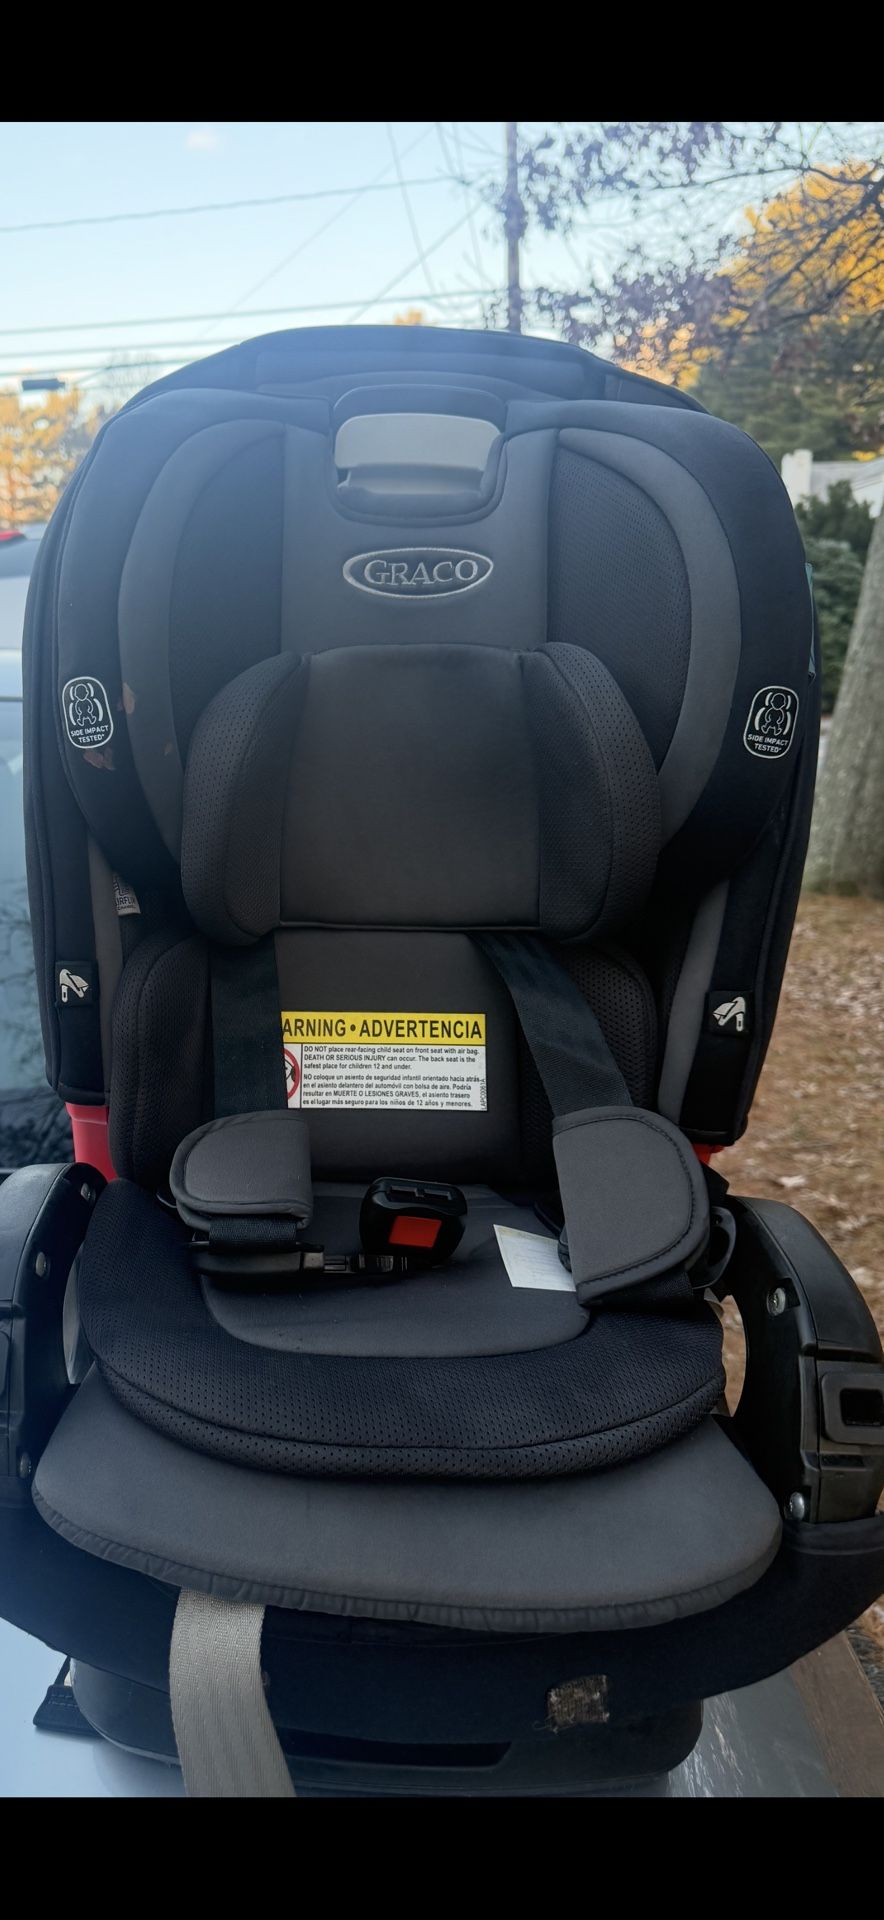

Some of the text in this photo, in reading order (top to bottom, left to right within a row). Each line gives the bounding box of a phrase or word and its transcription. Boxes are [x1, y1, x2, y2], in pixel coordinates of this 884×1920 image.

[364, 559, 478, 586] GRACO
[71, 725, 109, 737] SIDE IMPACT
[747, 733, 789, 746] SIDE IMPACT
[283, 1018, 482, 1039] ARNING ADVERTENCIA
[344, 1046, 376, 1054] rear-facing
[466, 1048, 480, 1056] bag.
[313, 1073, 335, 1081] coloque
[373, 1074, 401, 1082] seguridad
[364, 1090, 394, 1098] LESIONES
[428, 1091, 450, 1099] asiento
[316, 1098, 331, 1106] lugar
[344, 1099, 365, 1107] seguro
